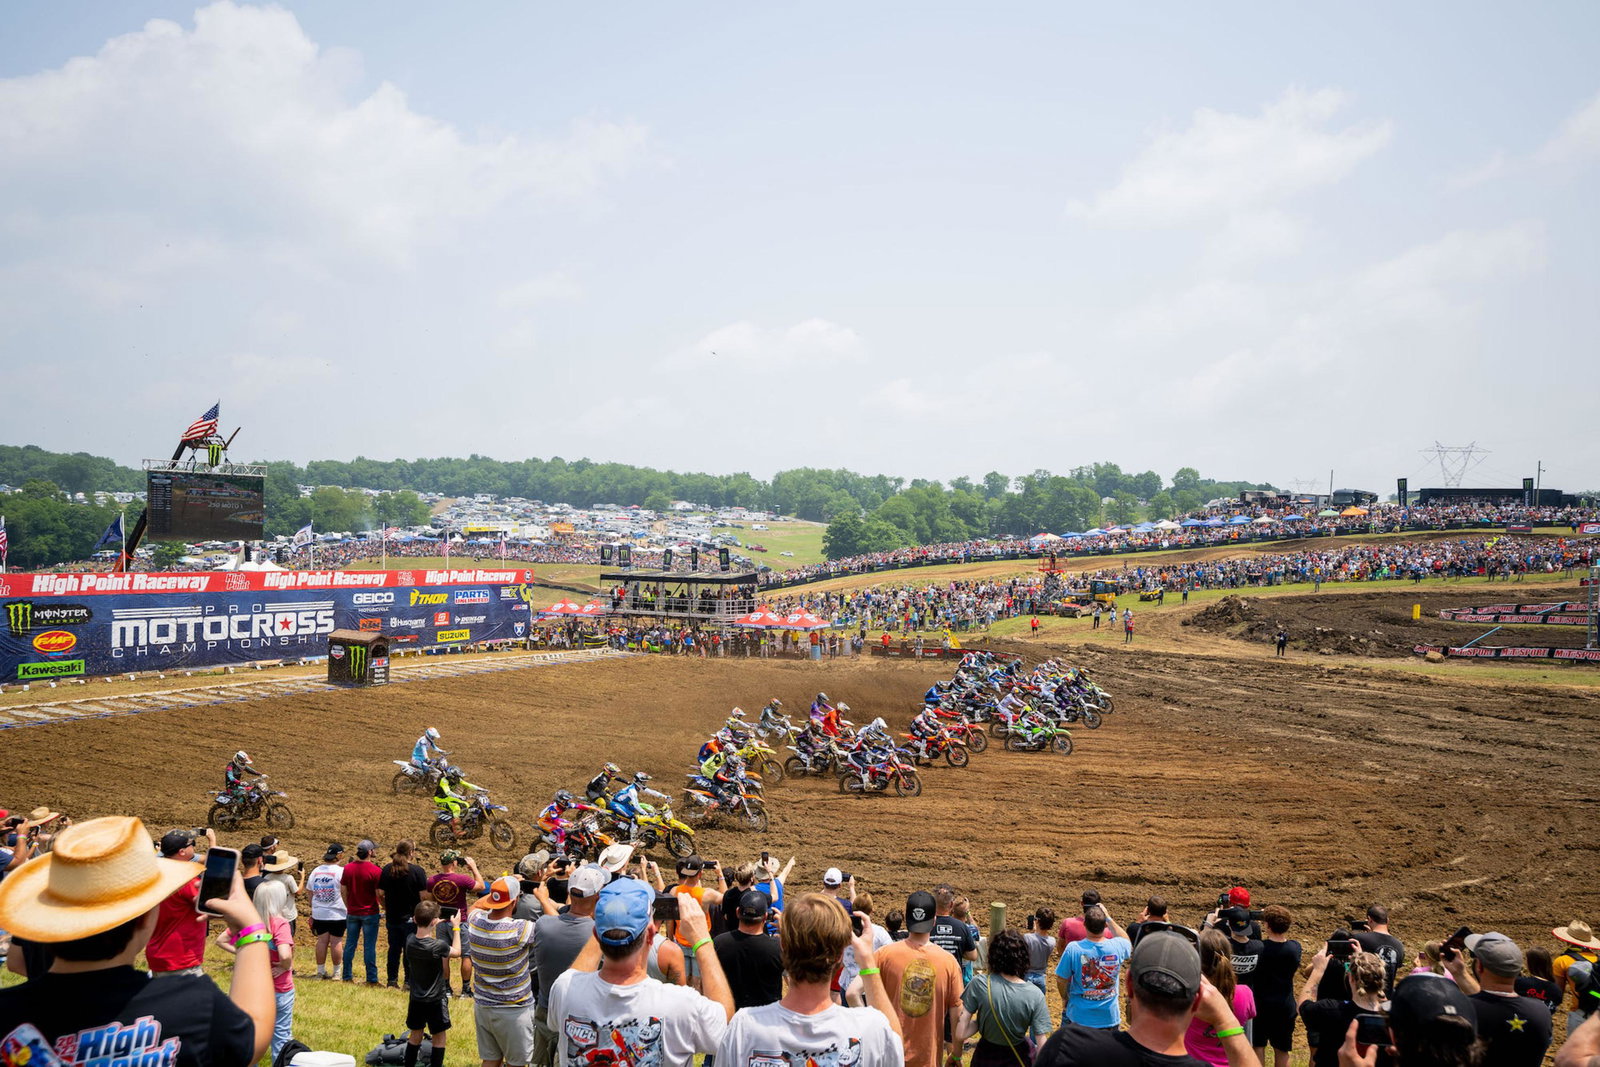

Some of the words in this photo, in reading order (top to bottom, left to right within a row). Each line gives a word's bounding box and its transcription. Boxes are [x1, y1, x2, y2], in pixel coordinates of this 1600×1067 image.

[225, 573, 245, 583] High
[264, 572, 299, 588] High
[298, 572, 331, 586] Point
[331, 572, 387, 586] Raceway
[425, 570, 450, 585] High
[449, 570, 476, 583] Point
[476, 570, 517, 583] Raceway
[32, 574, 79, 595] High
[80, 574, 131, 592] Point
[132, 573, 211, 592] Raceway
[226, 580, 250, 590] Point
[353, 592, 395, 604] GEICO
[419, 593, 449, 604] THOR
[455, 590, 489, 598] PARTS
[34, 608, 88, 619] MONSTER
[205, 603, 262, 615] PRO
[37, 636, 73, 645] FMF
[440, 631, 468, 640] SUZUKI
[22, 663, 82, 676] Kawasaki
[76, 1018, 157, 1062] High
